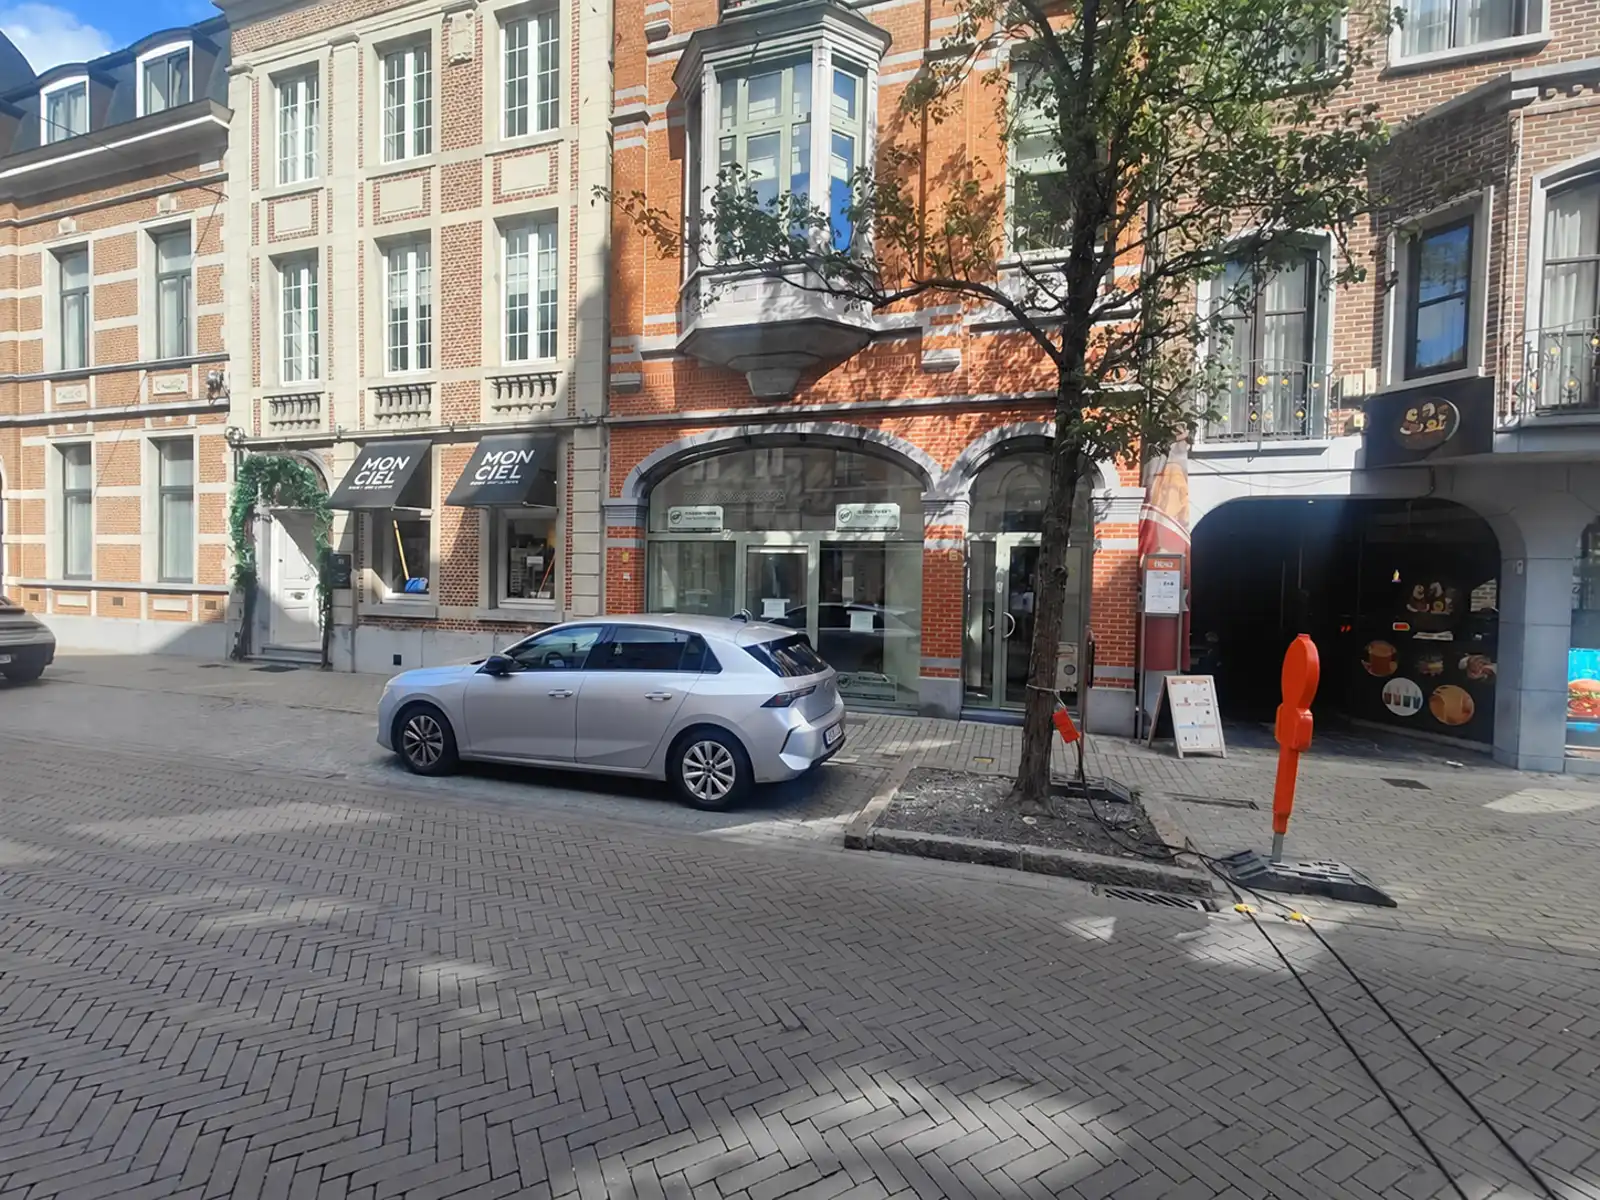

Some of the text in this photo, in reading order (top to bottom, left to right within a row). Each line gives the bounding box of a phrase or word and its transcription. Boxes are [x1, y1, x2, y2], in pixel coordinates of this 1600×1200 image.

[360, 455, 411, 471] MON
[480, 449, 535, 465] MON
[353, 470, 395, 485] CIEL
[474, 464, 522, 480] CIEL
